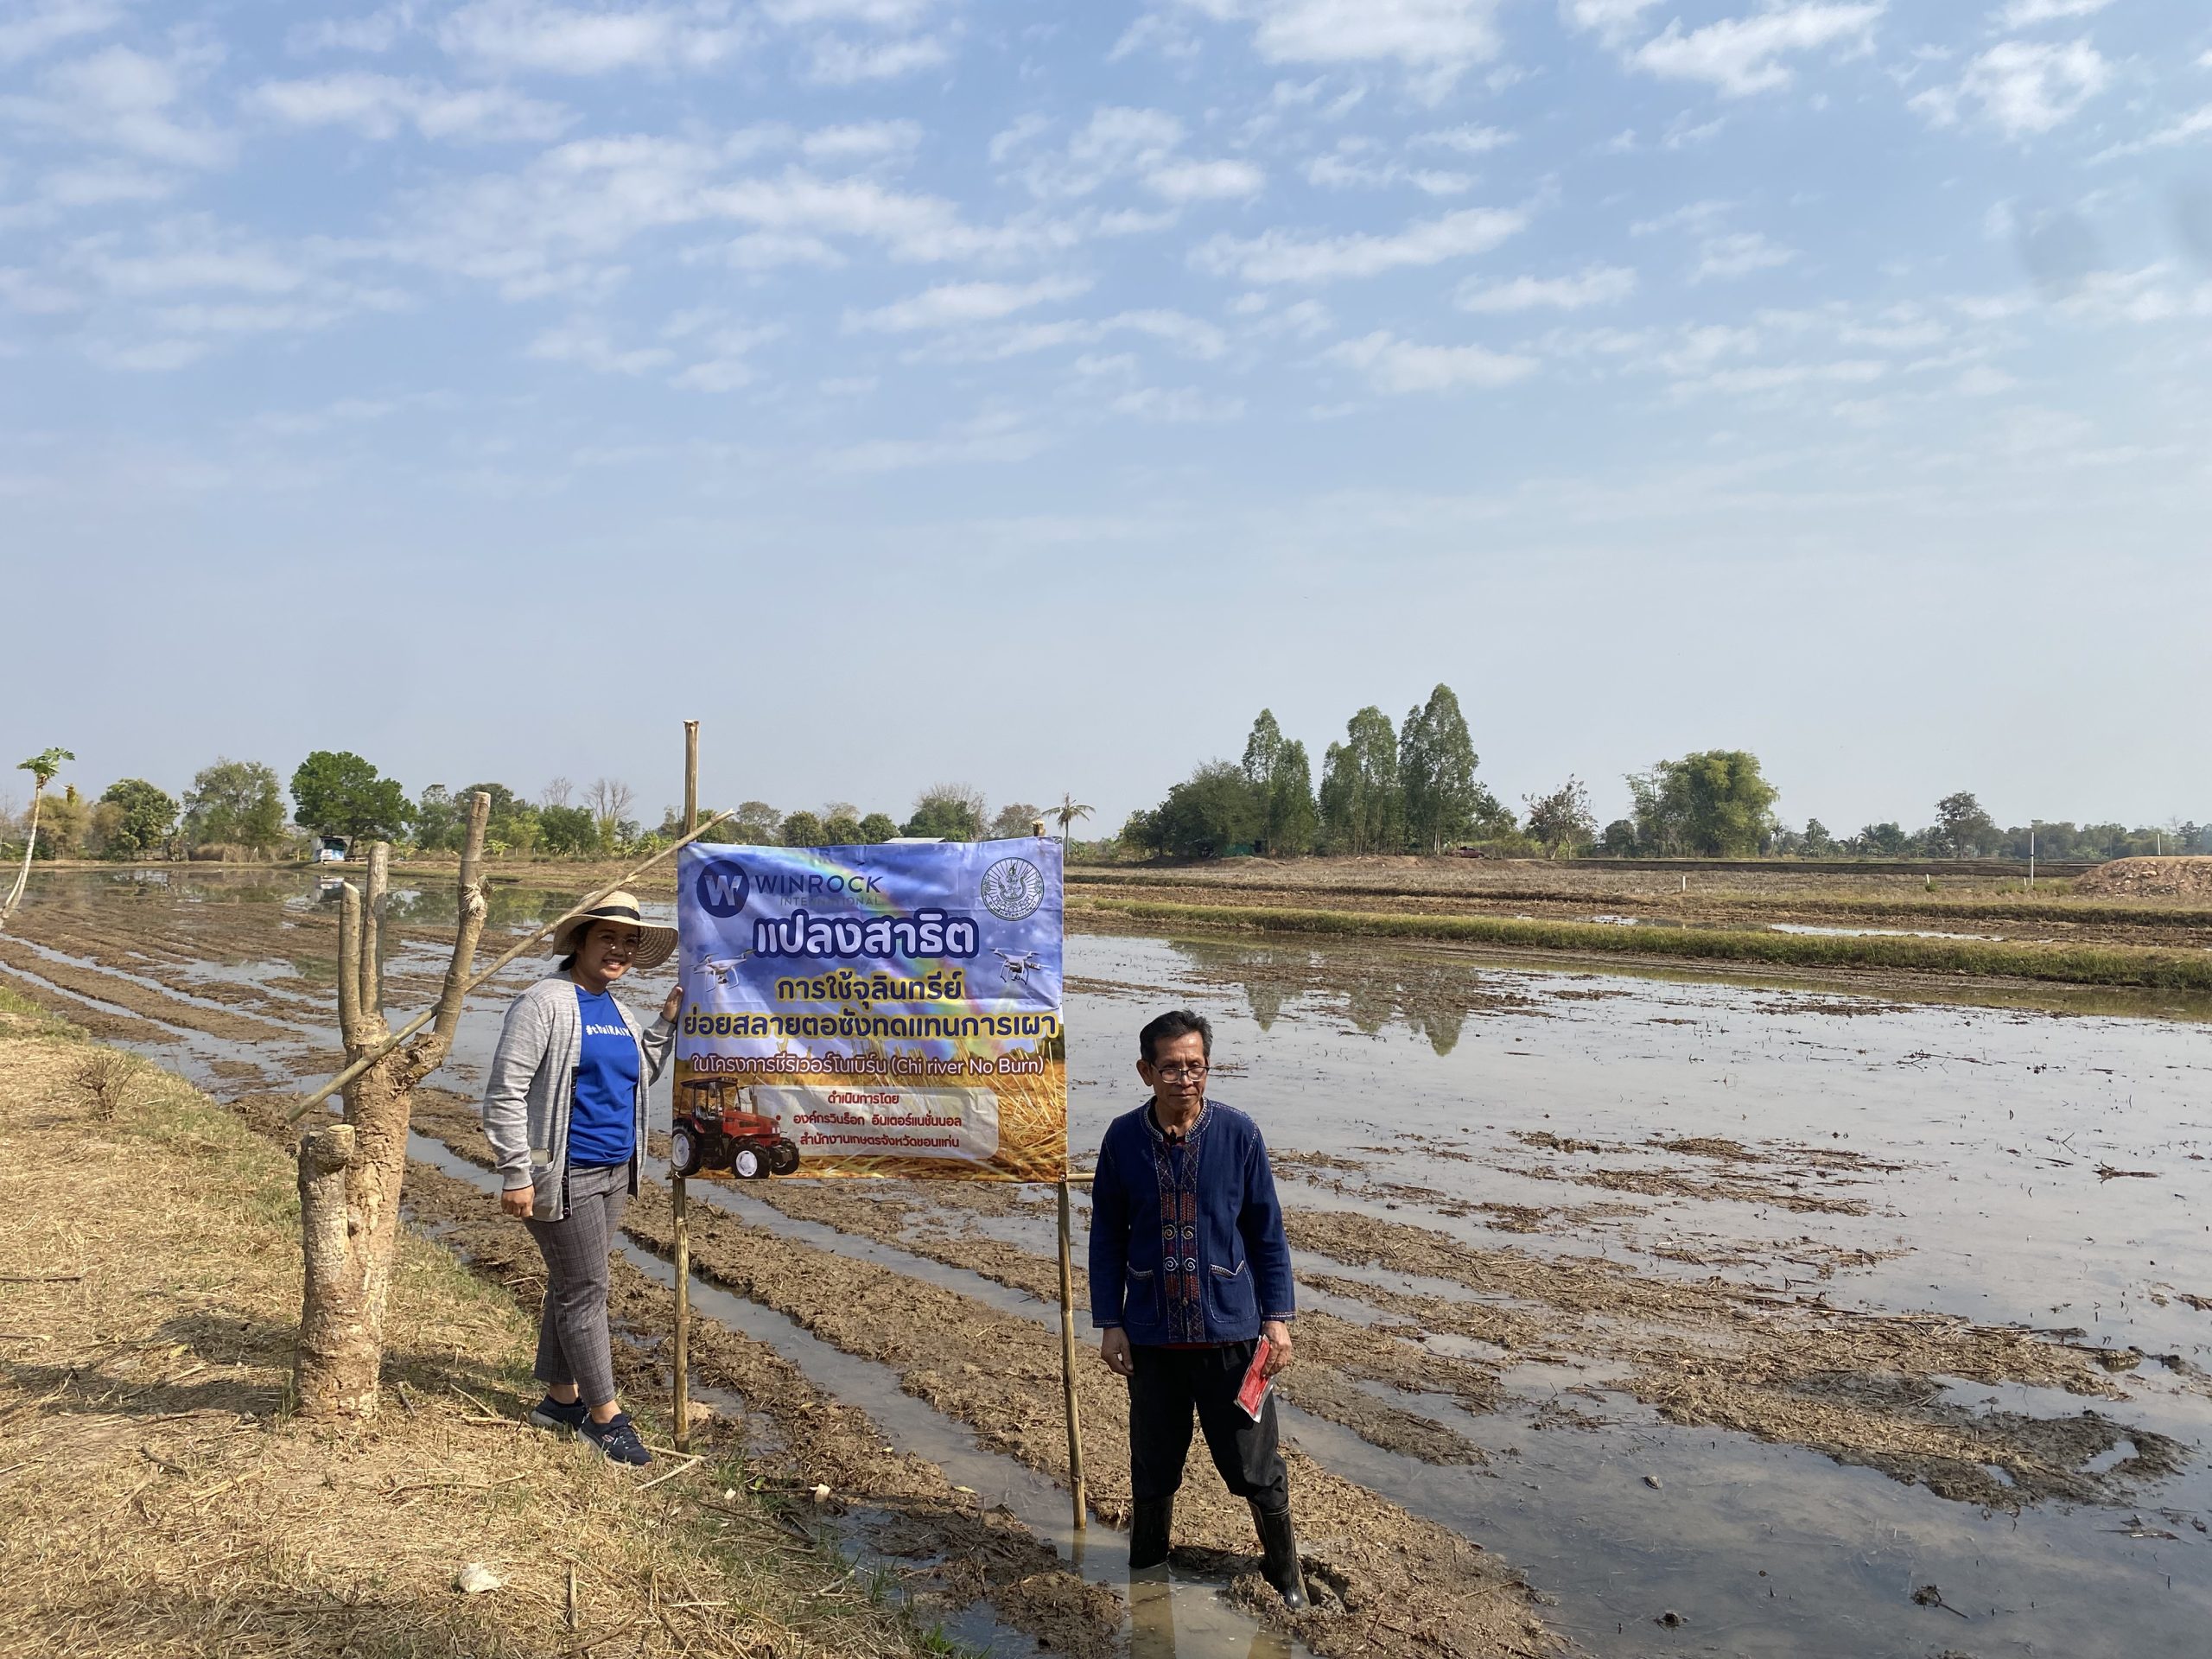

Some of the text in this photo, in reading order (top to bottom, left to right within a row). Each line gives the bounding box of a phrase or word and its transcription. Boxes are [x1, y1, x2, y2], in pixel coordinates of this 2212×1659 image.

[704, 874, 743, 906] W
[755, 874, 884, 893] WINROCK
[757, 912, 974, 954] แปลงสาธิต
[778, 970, 963, 1009] การใช้จุลินทรีย์
[683, 1006, 1056, 1037] ย่อยสลายตอซังทดแทนการเผา
[692, 1051, 1044, 1076] ในโครงการชีริเวอร์โนเบิร์น (Chi river No Burn)
[828, 1090, 899, 1104] ดำเนินการโดย
[793, 1110, 865, 1126] องค์กรวินร็อก
[800, 1130, 960, 1147] สำนักงานเกษตรจังหวัดขอนแก่น
